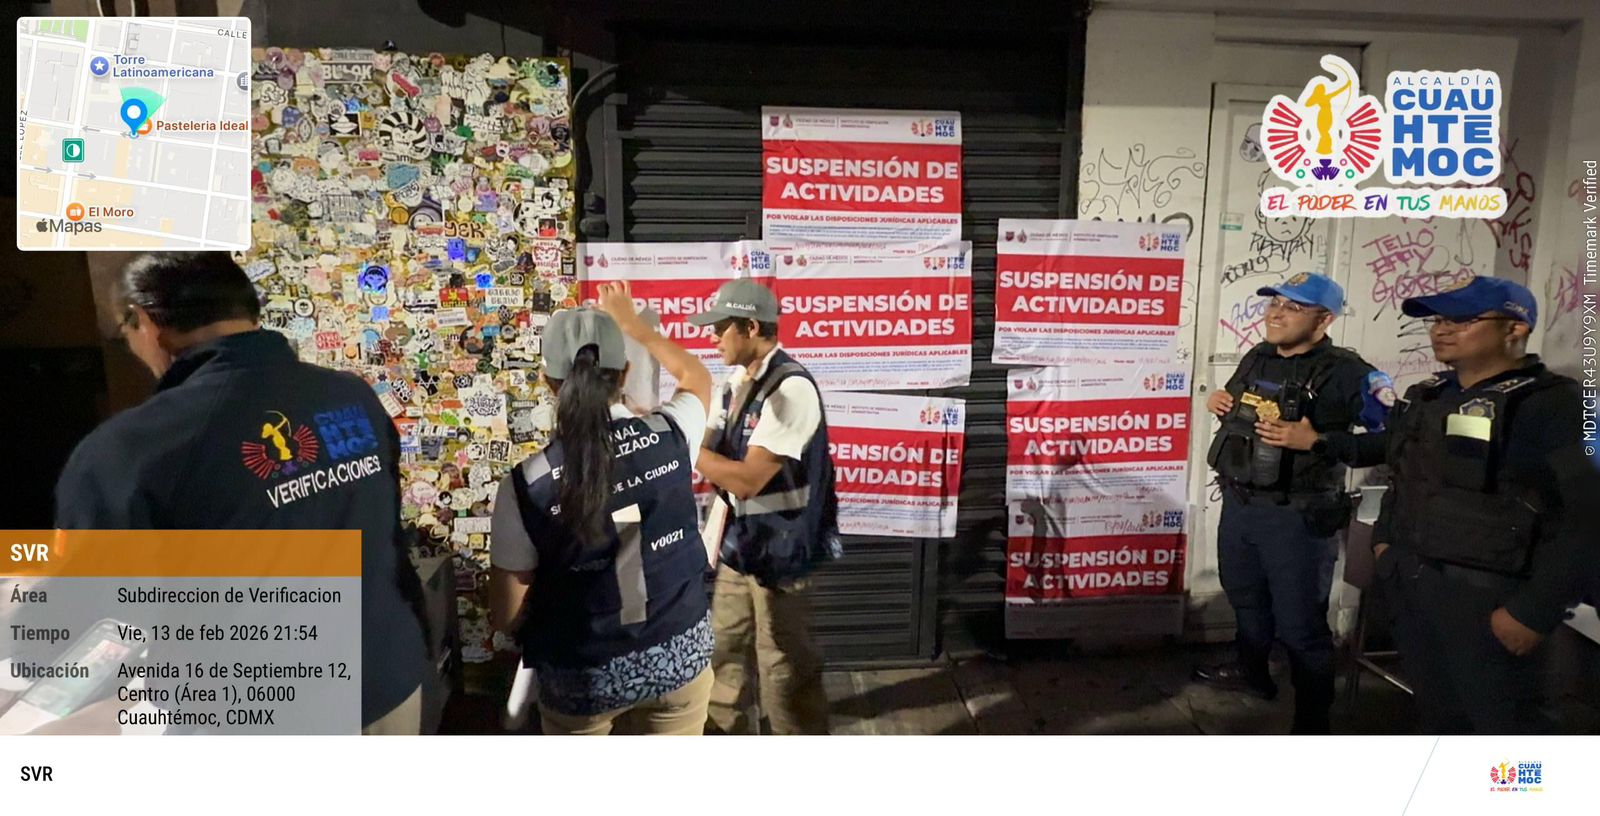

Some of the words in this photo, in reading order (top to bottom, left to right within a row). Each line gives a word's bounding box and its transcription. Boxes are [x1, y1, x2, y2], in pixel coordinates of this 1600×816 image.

[767, 156, 920, 178] SUSPENSIÓN
[927, 162, 958, 179] DE
[781, 182, 944, 203] ACTIVIDADES
[879, 216, 915, 224] JURÍDICAS
[1000, 270, 1143, 291] SUSPENSIÓN
[1150, 275, 1179, 292] DE
[780, 290, 931, 313] SUSPENSIÓN
[939, 294, 968, 310] DE
[1012, 296, 1164, 315] ACTIVIDADES
[795, 318, 955, 338] ACTIVIDADES
[1010, 411, 1149, 433] SUSPENSIÓN
[1157, 413, 1186, 429] DE
[828, 442, 924, 463] PENSIÓN
[930, 448, 959, 465] DE
[1024, 437, 1172, 456] ACTIVIDADES
[267, 455, 382, 509] VERIFICACIONES
[627, 476, 643, 488] LA
[645, 460, 680, 481] CIUDAD
[834, 467, 942, 487] IVIDADES
[651, 529, 684, 551] V0021
[1010, 546, 1147, 568] SUSPENSIÓN
[1154, 549, 1183, 564] DE
[1023, 571, 1169, 590] ACTIVIDADES
